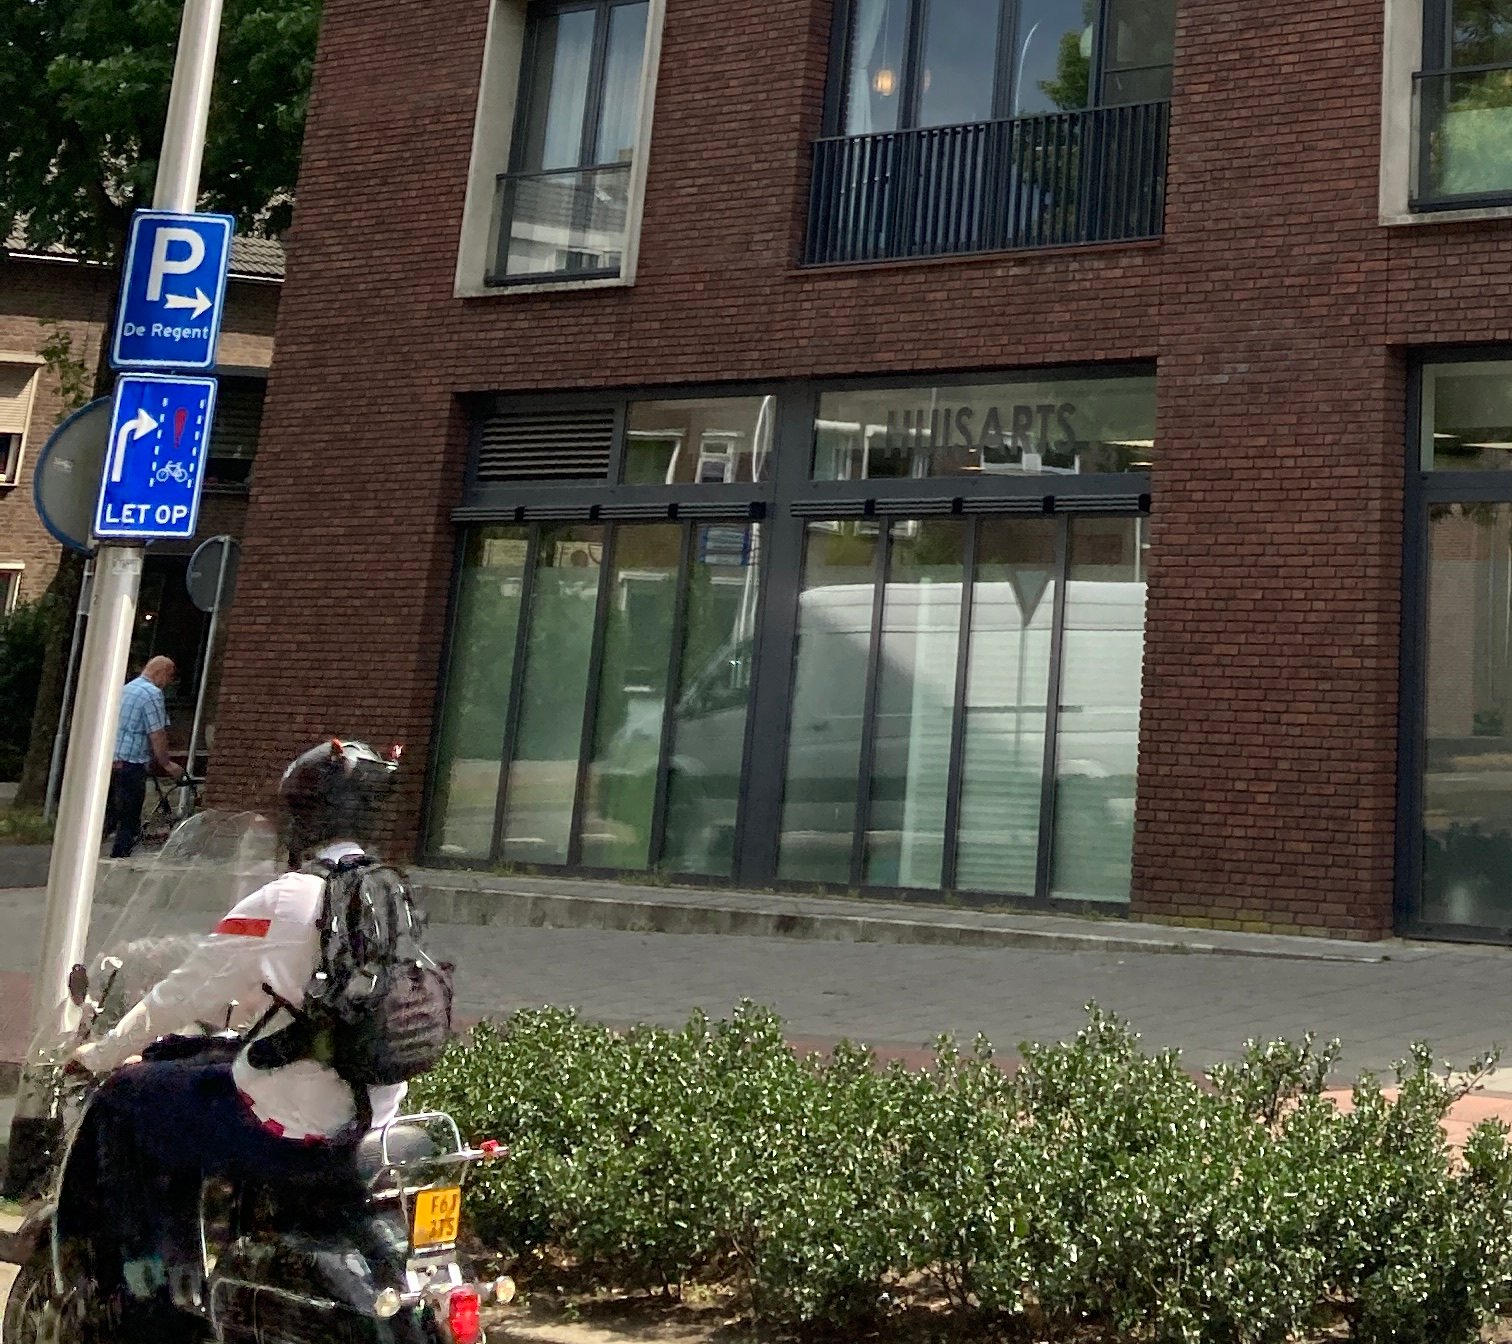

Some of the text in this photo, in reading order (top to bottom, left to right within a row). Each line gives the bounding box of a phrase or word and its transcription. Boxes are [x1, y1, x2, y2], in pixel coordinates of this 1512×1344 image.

[146, 227, 205, 301] P
[123, 322, 209, 342] De Regent
[105, 503, 187, 525] LET OP
